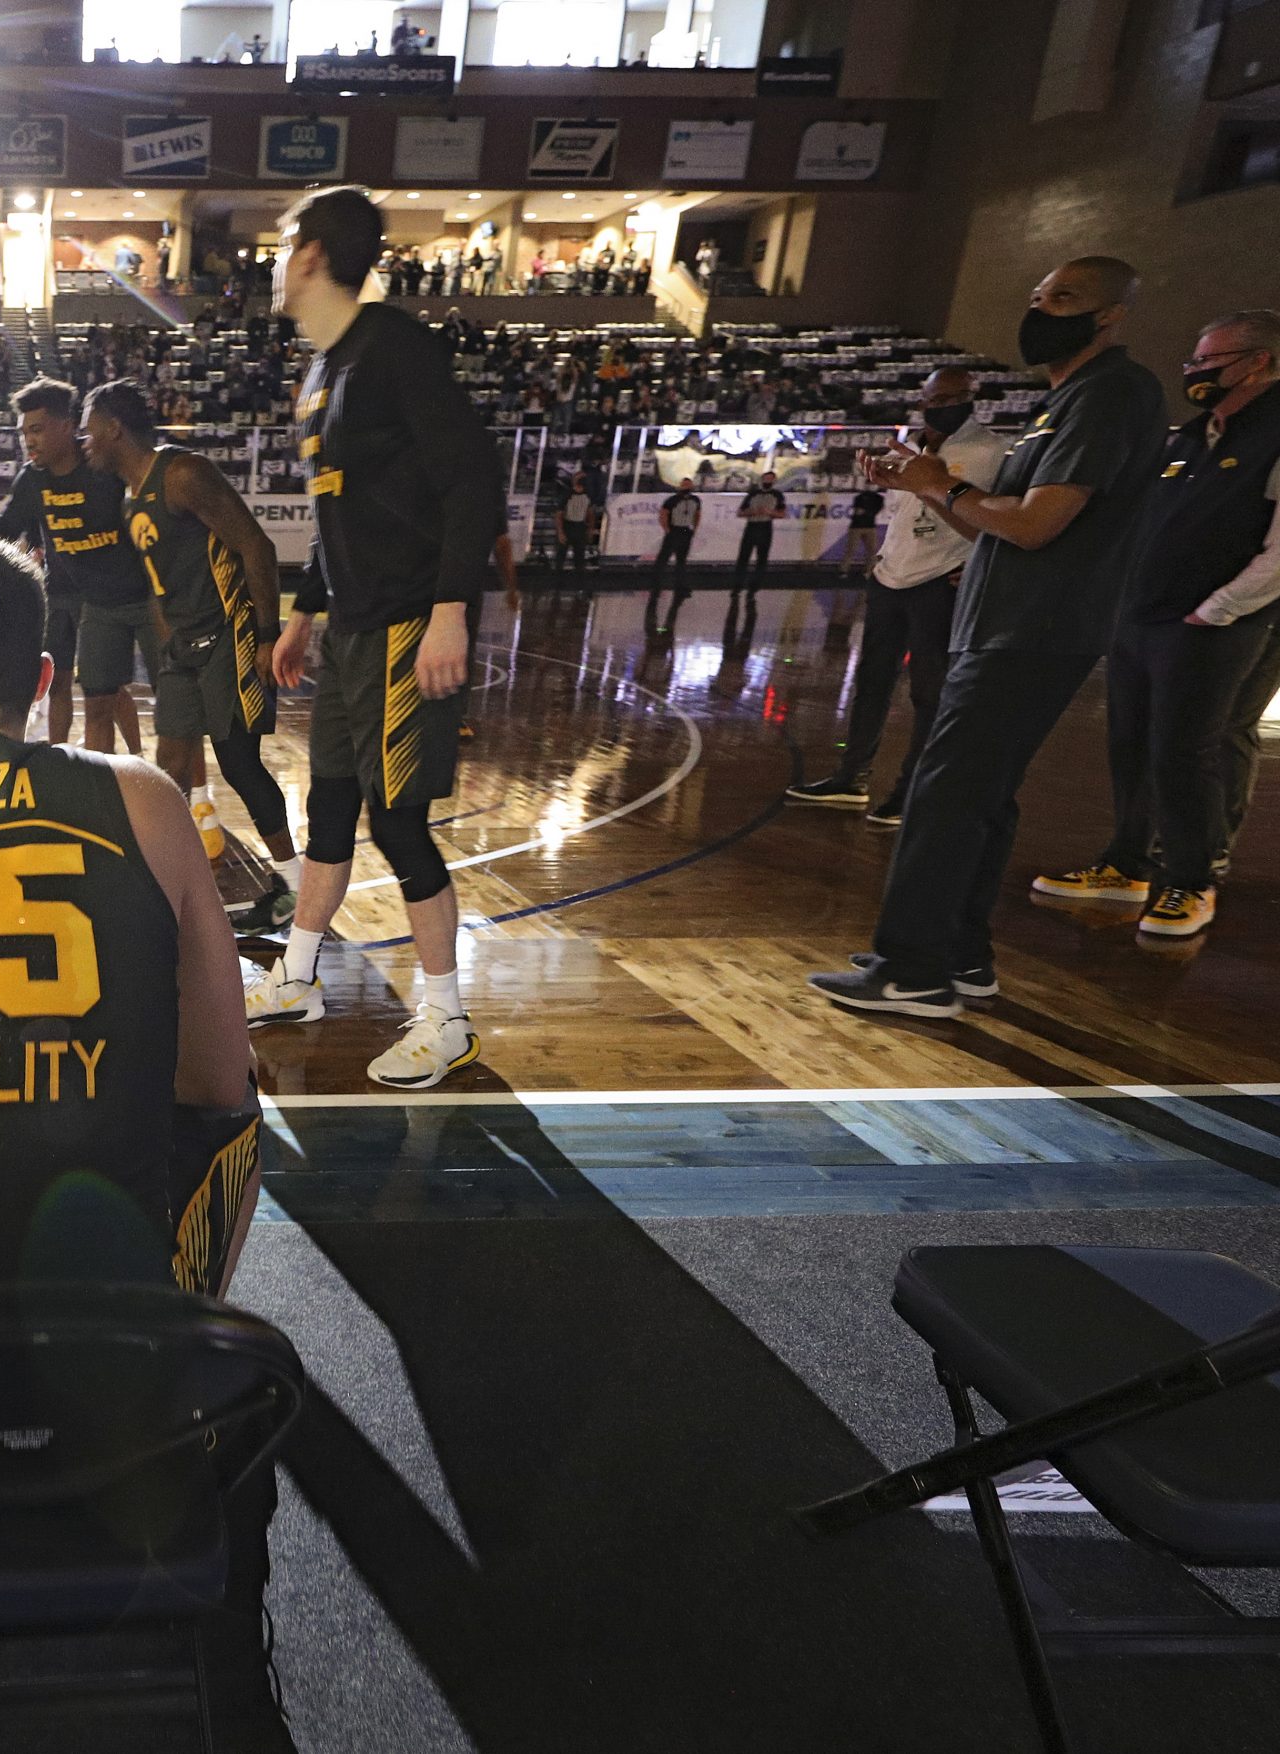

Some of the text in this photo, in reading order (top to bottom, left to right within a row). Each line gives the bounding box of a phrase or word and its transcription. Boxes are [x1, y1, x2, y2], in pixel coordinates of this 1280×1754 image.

[148, 133, 205, 160] LEWIS
[41, 489, 86, 507] Peace
[254, 505, 314, 521] PENT
[45, 514, 85, 531] Love
[52, 531, 119, 555] Equality
